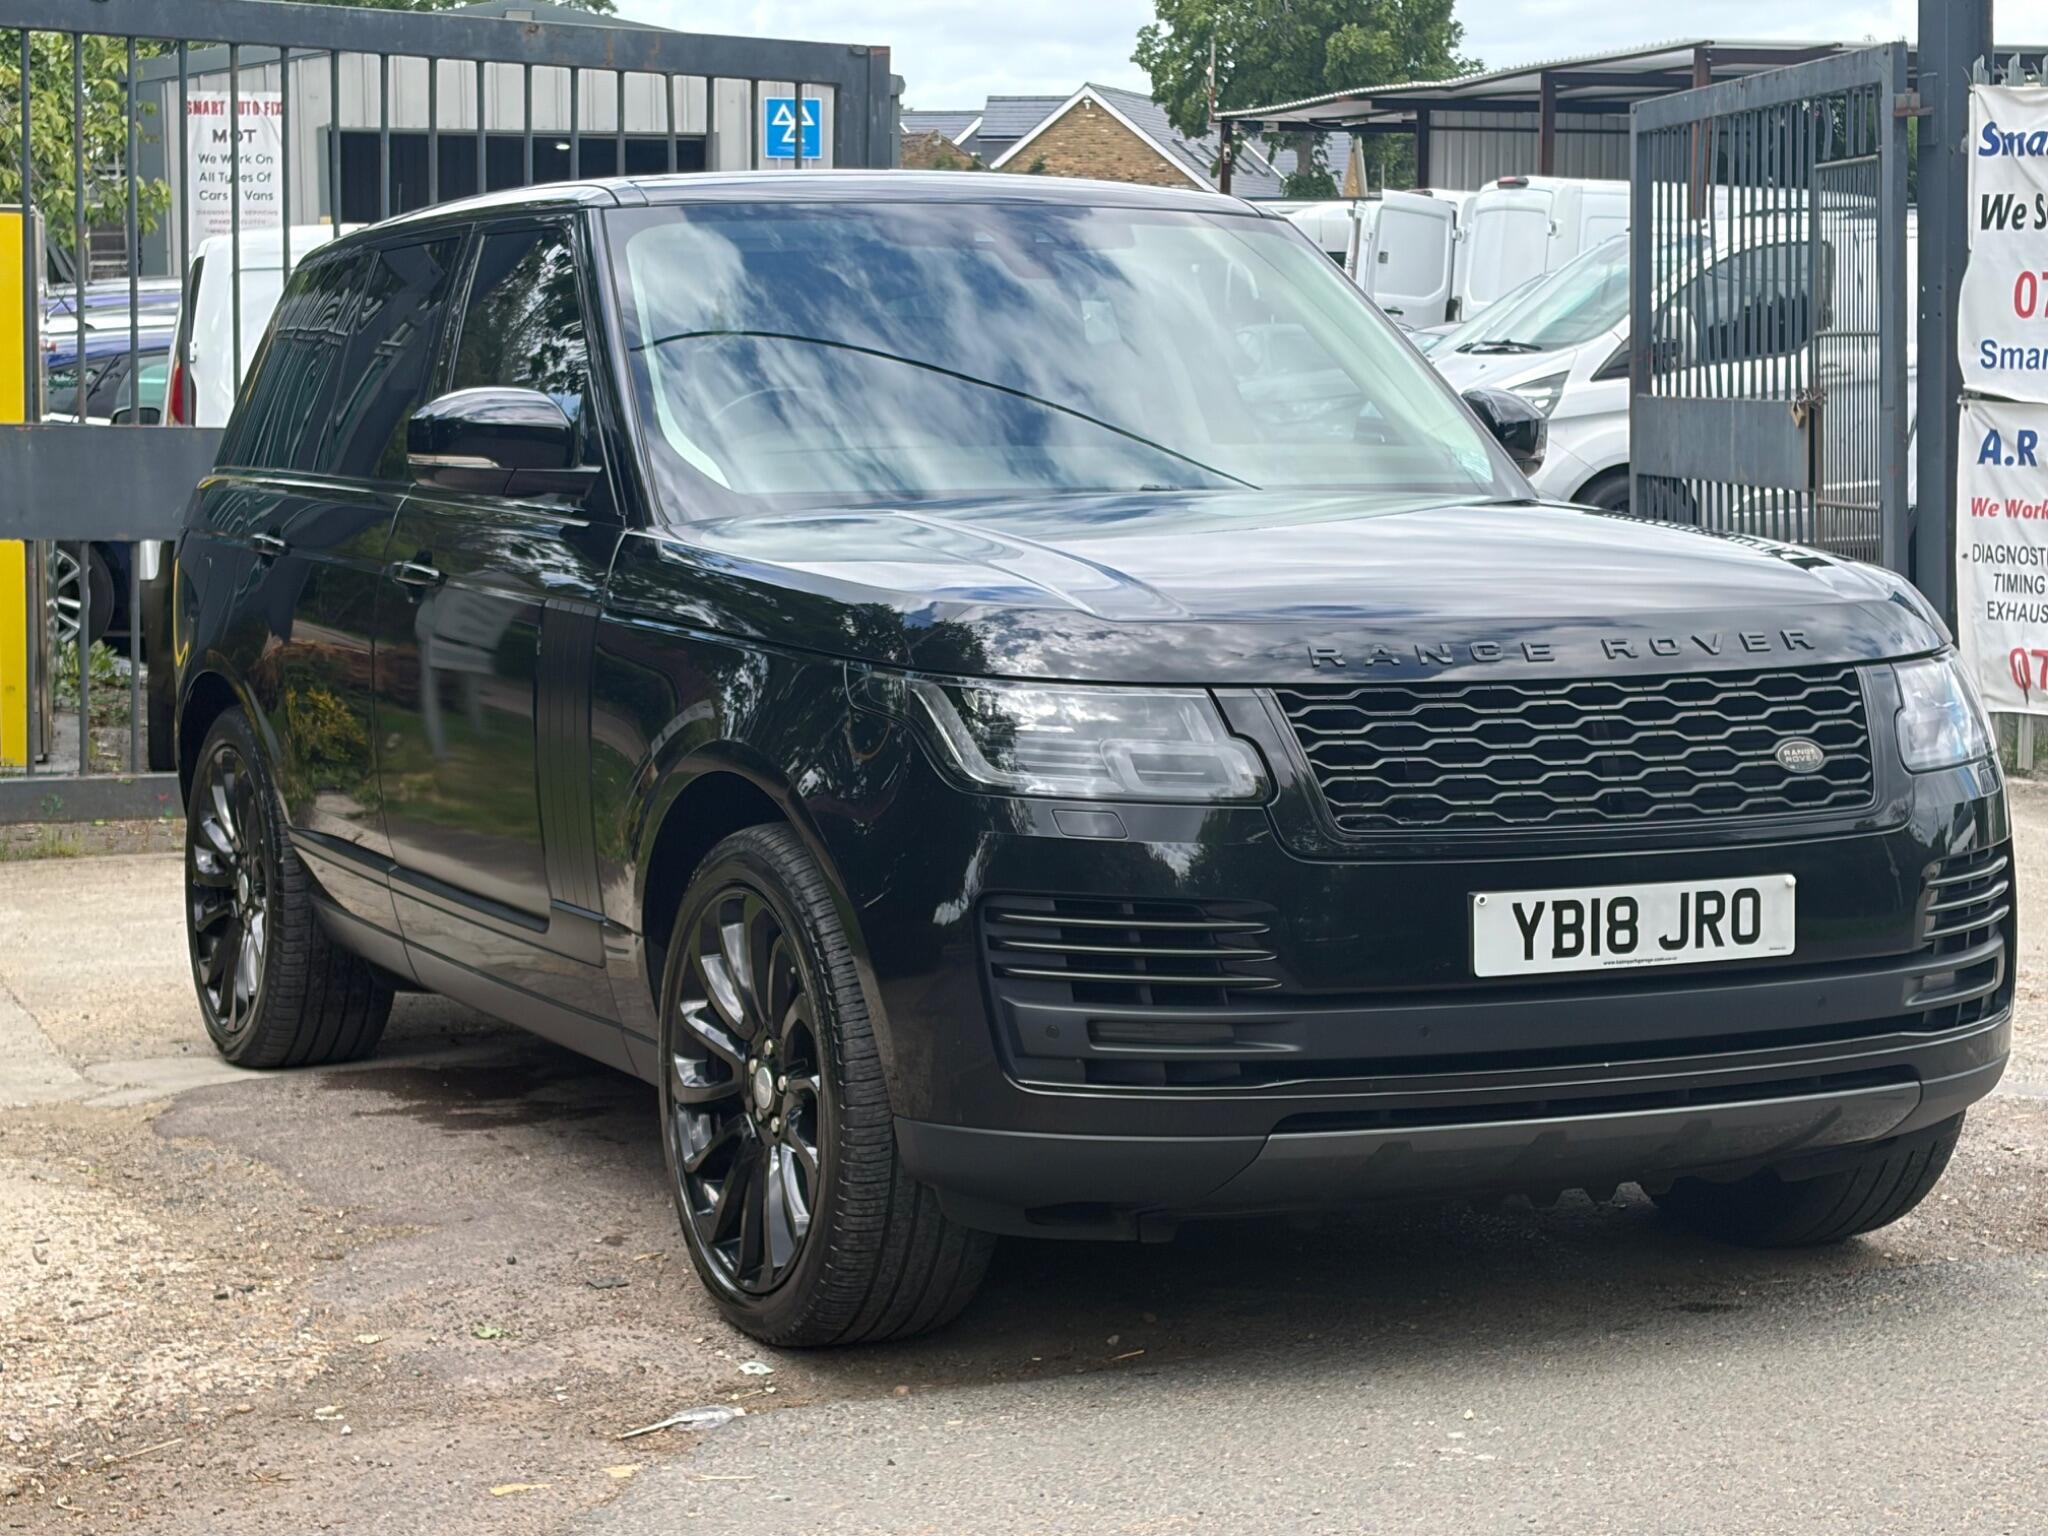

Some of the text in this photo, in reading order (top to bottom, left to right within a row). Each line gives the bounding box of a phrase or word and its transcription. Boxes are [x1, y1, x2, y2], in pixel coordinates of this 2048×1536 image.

[231, 100, 260, 116] UTO
[1978, 121, 2048, 157] Sma
[198, 153, 273, 164] We Wrk On
[199, 172, 272, 184] All Tyes Of
[199, 190, 274, 201] Cars Vans
[1981, 194, 2027, 230] We
[1977, 429, 2038, 467] A.R
[1971, 497, 2000, 517] We
[1993, 573, 2046, 595] TIMING
[1308, 629, 1816, 668] RANGE ROVER
[1512, 887, 1762, 961] YB18 JRO
